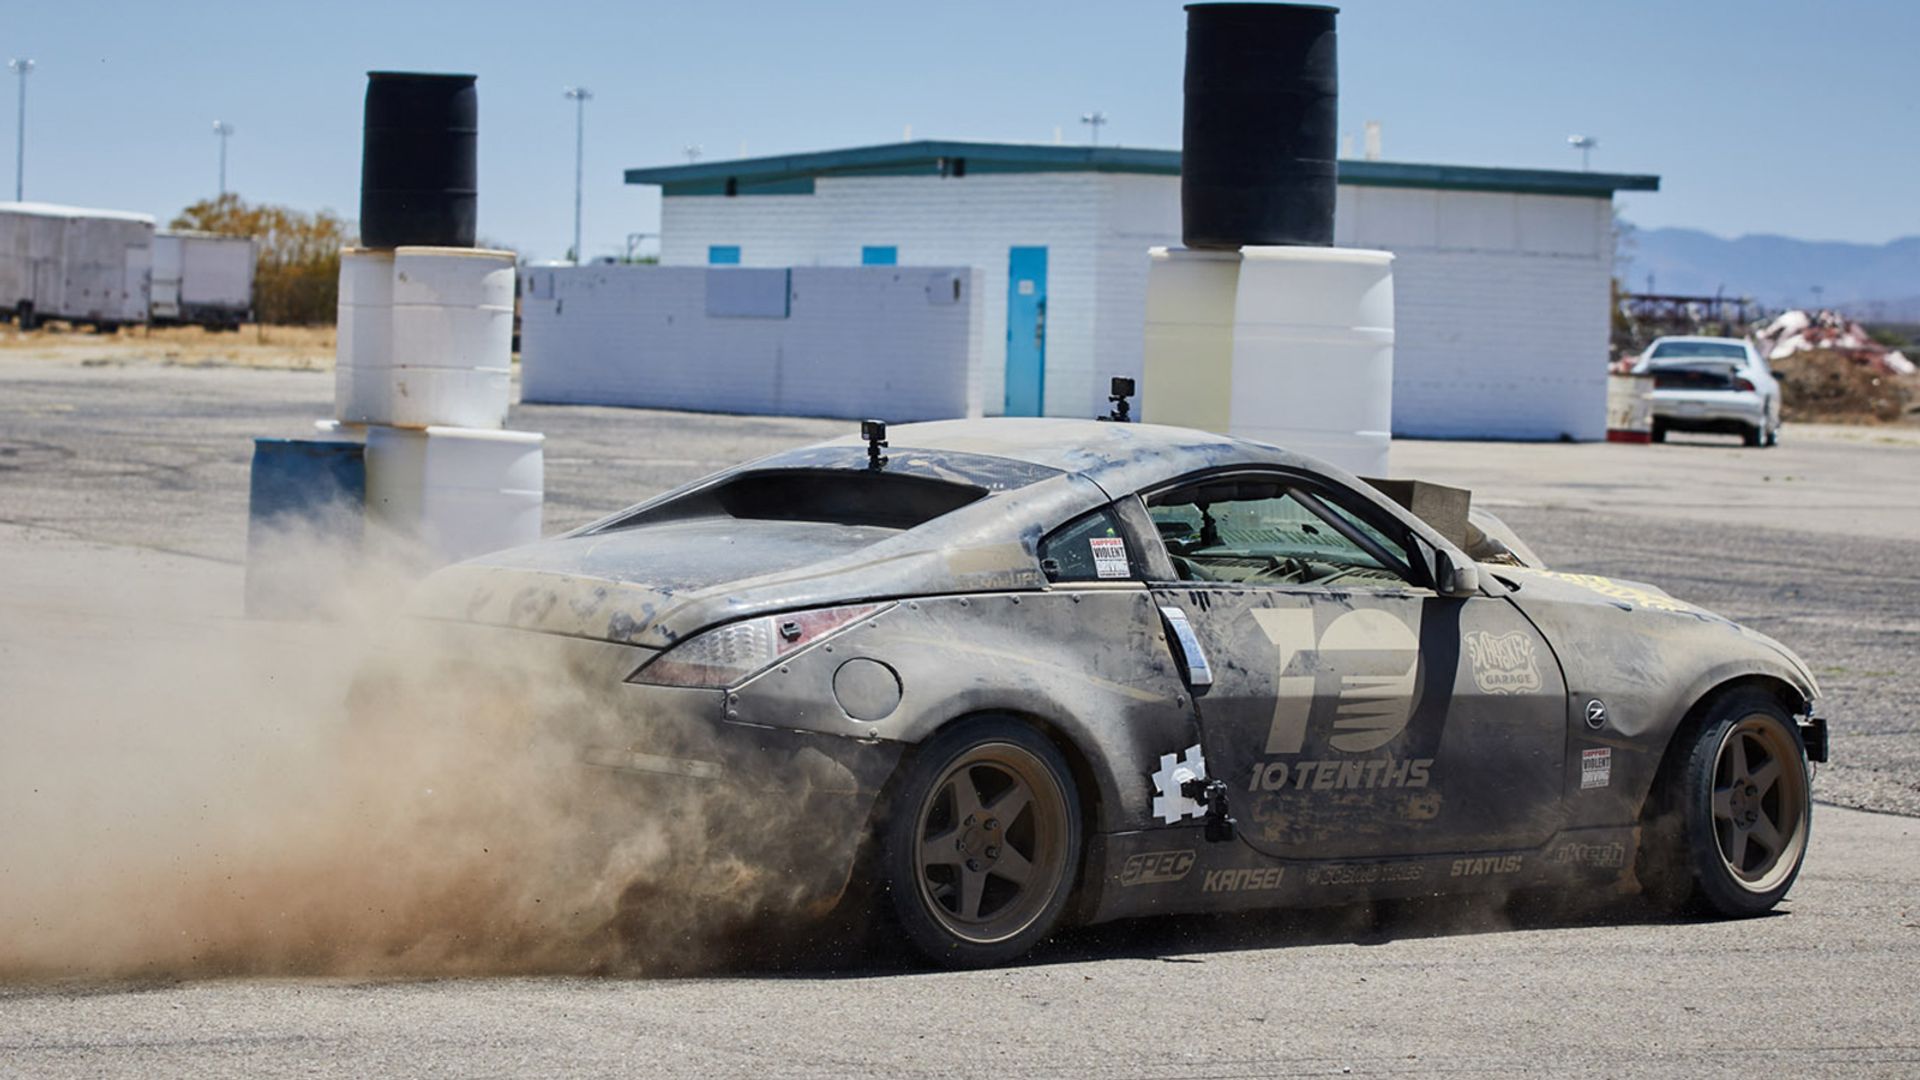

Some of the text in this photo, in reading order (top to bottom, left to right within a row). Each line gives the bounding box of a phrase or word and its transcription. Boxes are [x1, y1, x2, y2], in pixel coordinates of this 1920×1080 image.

[1094, 547, 1125, 559] VIOLENT
[1485, 674, 1532, 685] GARAGE
[1248, 758, 1435, 792] 10 TENTHS
[1121, 850, 1195, 882] SPEC
[1202, 866, 1286, 892] KANSEI
